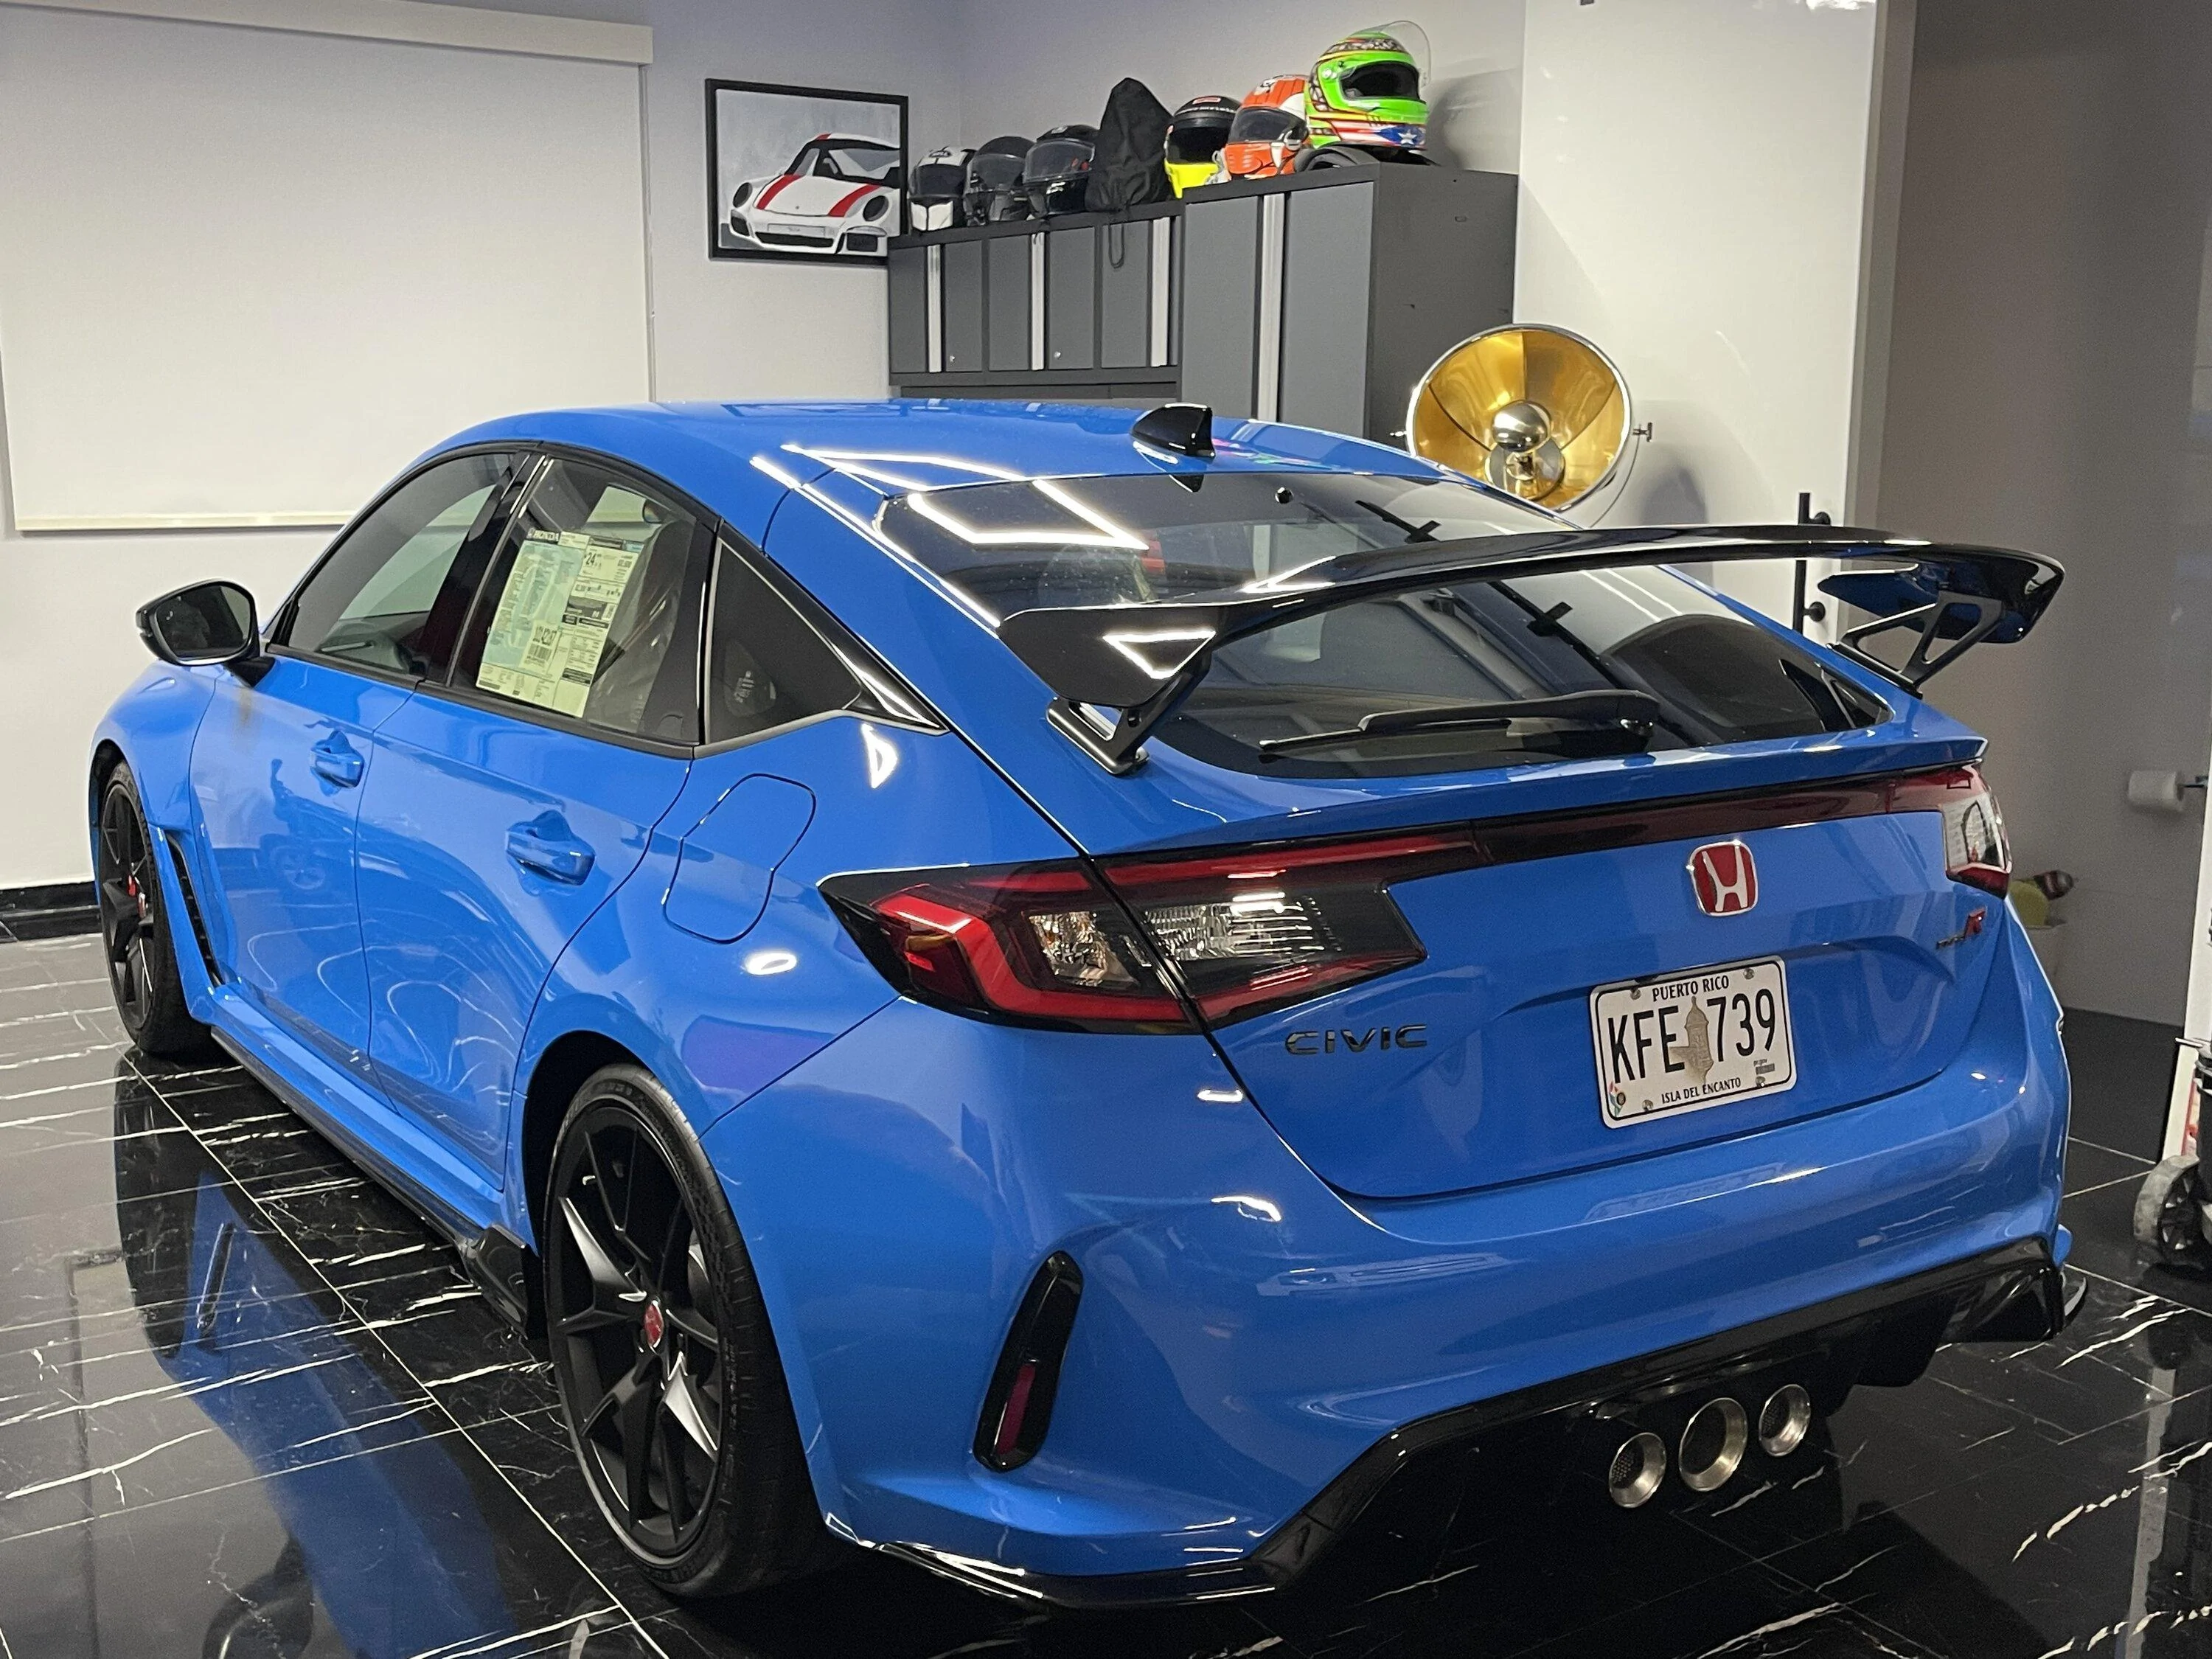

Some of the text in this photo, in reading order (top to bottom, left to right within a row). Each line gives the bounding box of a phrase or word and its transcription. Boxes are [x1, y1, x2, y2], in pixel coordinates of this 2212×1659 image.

[1652, 975, 1730, 1003] PUERTO RICO
[1285, 1023, 1427, 1055] CIVIC
[1607, 988, 1775, 1084] KFE 739
[1661, 1077, 1742, 1105] ISLA DEL ENCANTO
